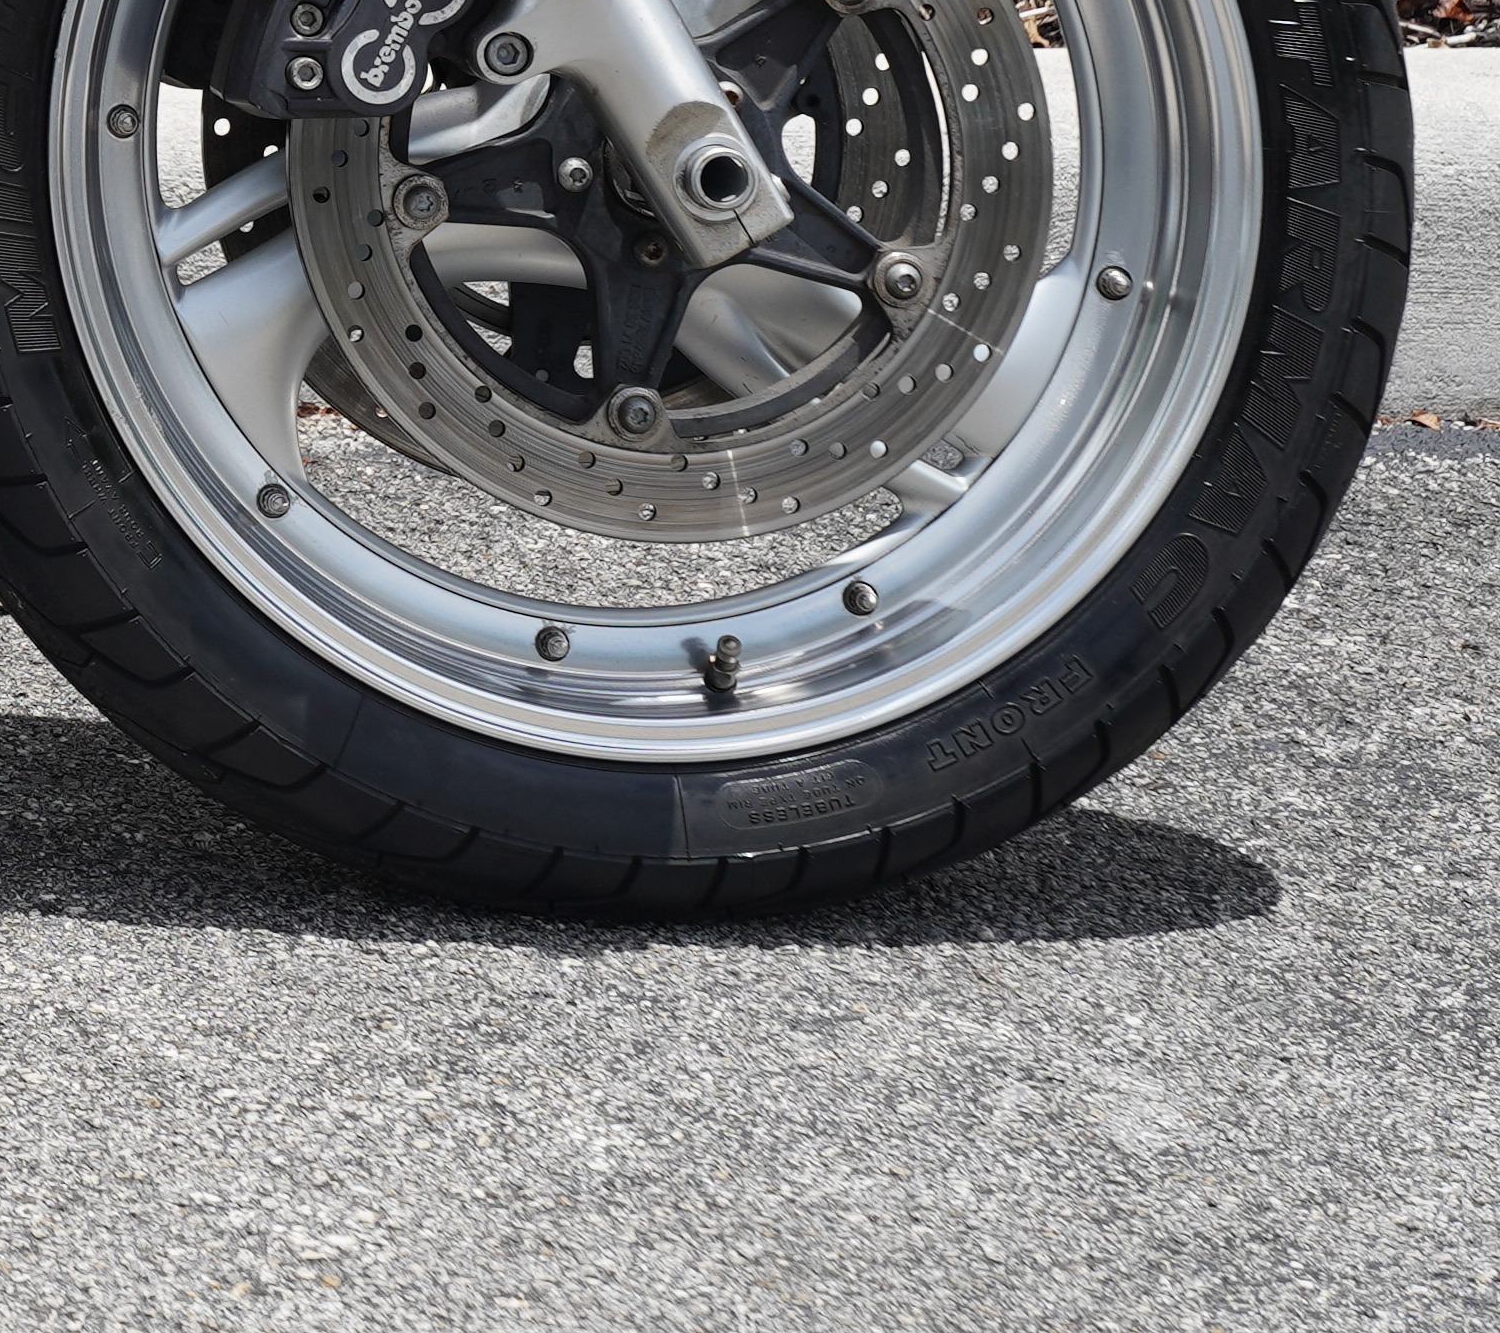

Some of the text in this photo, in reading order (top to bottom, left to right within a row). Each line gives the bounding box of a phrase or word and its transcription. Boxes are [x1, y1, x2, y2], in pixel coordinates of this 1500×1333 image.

[926, 654, 1096, 773] FRONT
[793, 776, 806, 788] A
[844, 772, 868, 790] ON
[726, 797, 753, 811] RIM
[758, 790, 798, 808] TYPE
[747, 789, 857, 830] TUBELESS
